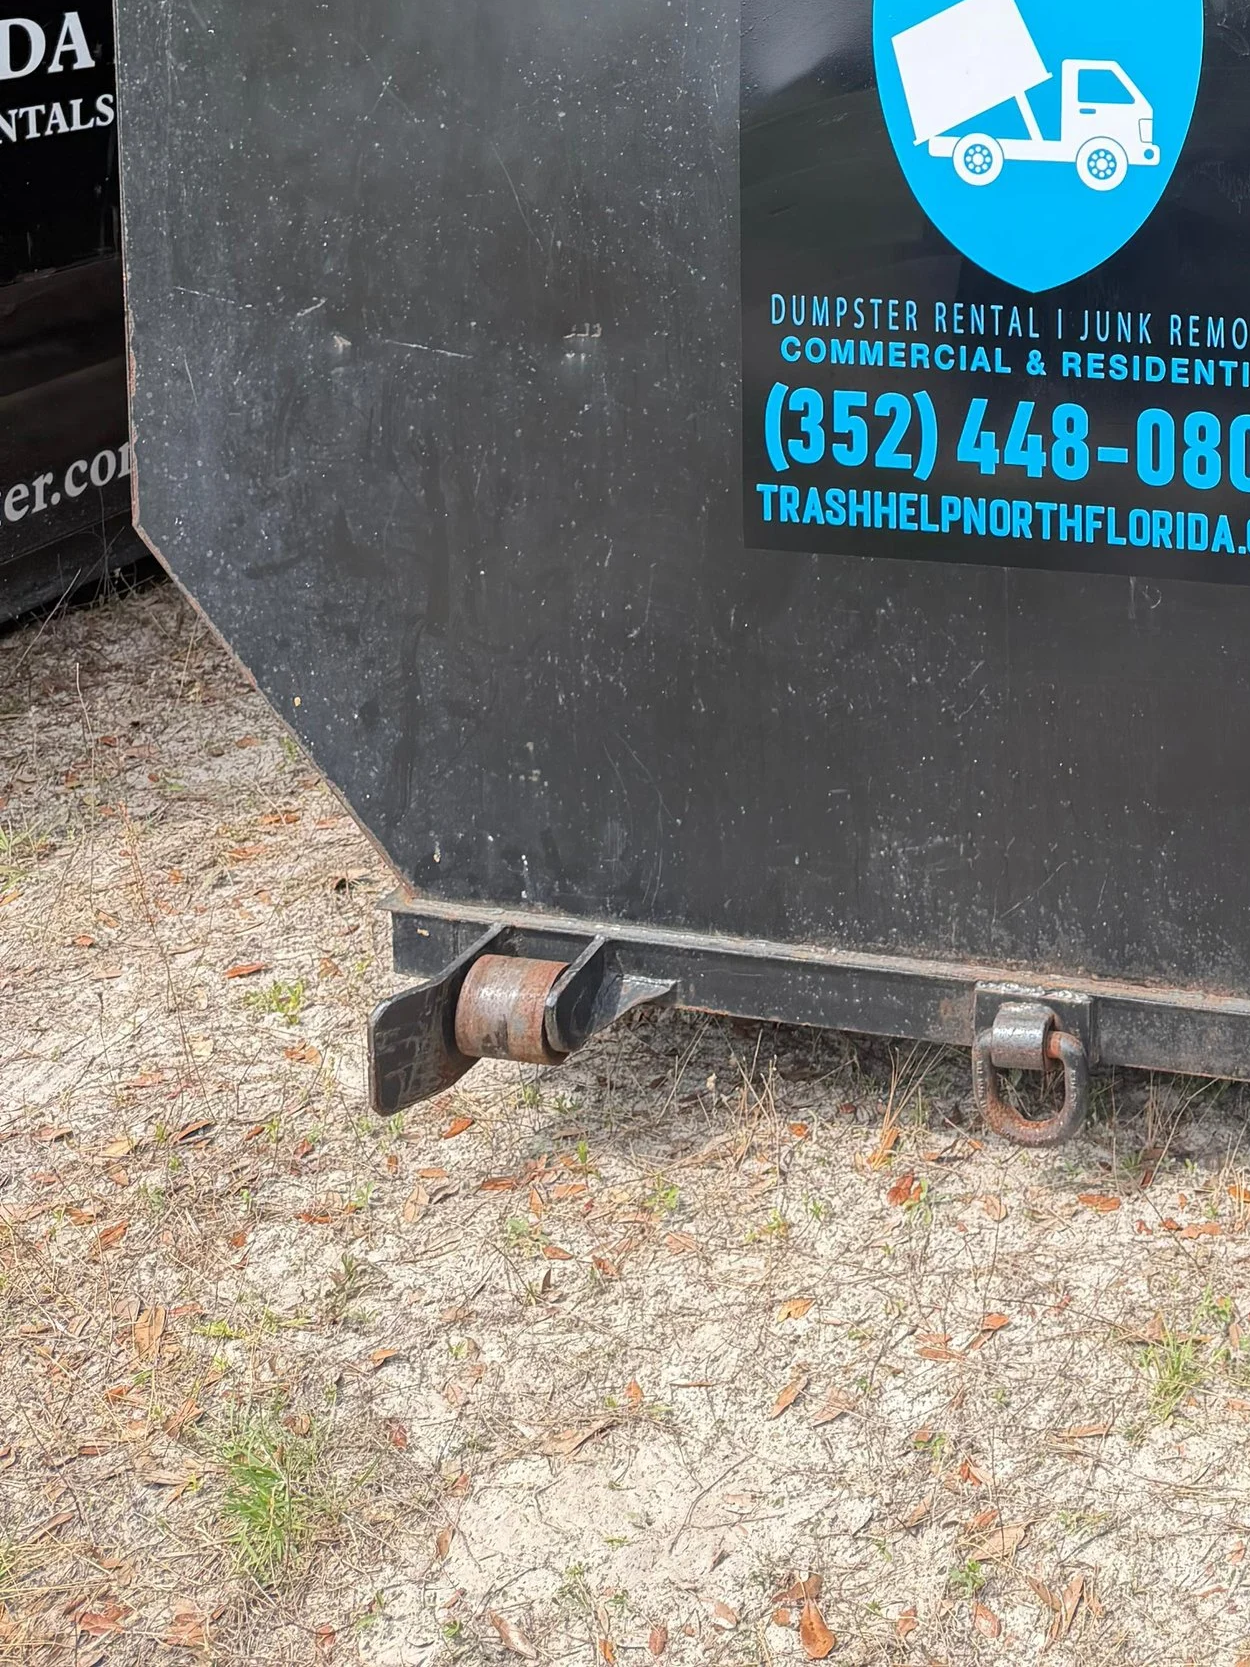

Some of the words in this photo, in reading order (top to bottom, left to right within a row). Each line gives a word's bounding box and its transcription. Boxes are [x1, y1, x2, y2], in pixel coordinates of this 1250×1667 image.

[771, 293, 918, 331] DUMPSTER
[935, 301, 1040, 338] RENTAL
[1079, 311, 1152, 346] JUNK
[780, 337, 1012, 374] COMMERCIAL
[1026, 349, 1048, 377] &
[764, 381, 938, 481] (352)
